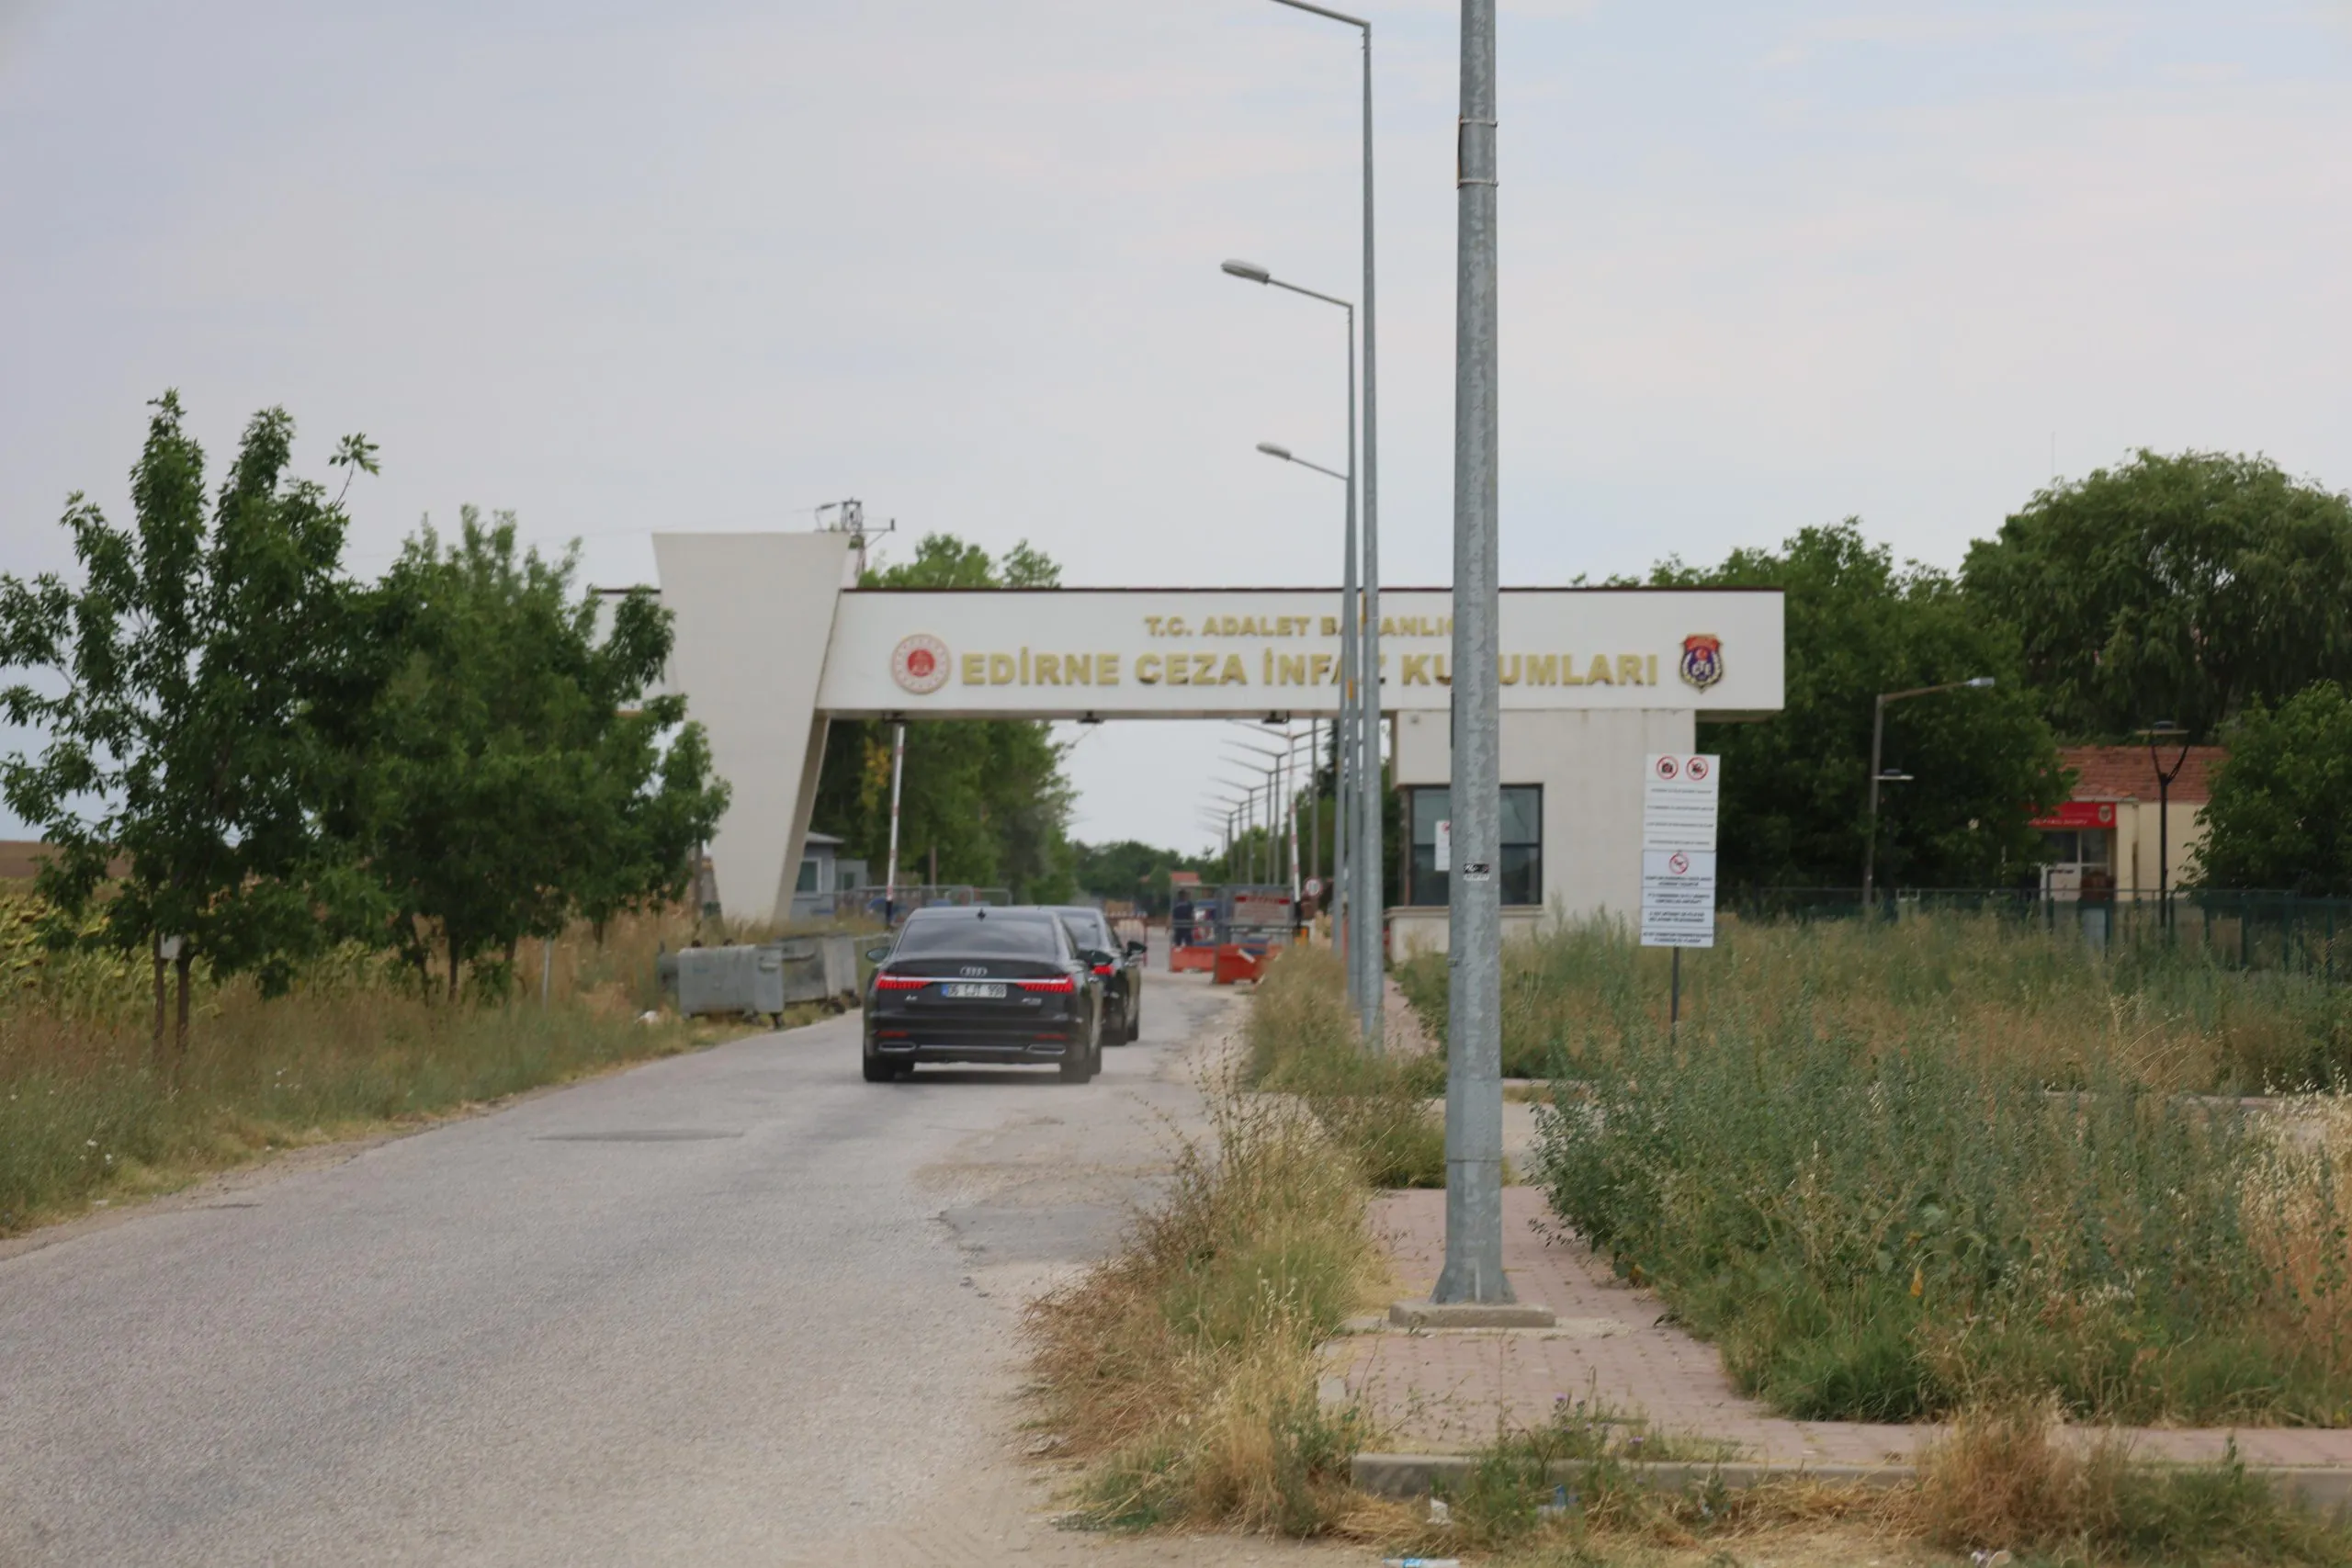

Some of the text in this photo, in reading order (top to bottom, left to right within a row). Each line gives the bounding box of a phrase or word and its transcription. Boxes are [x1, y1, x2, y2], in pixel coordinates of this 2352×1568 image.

[1146, 615, 1192, 637] T.C.
[1202, 616, 1310, 637] ADALET
[961, 647, 1120, 685] EDİRNE
[1136, 653, 1248, 685] CEZA
[1401, 653, 1657, 686] KUUMLARI
